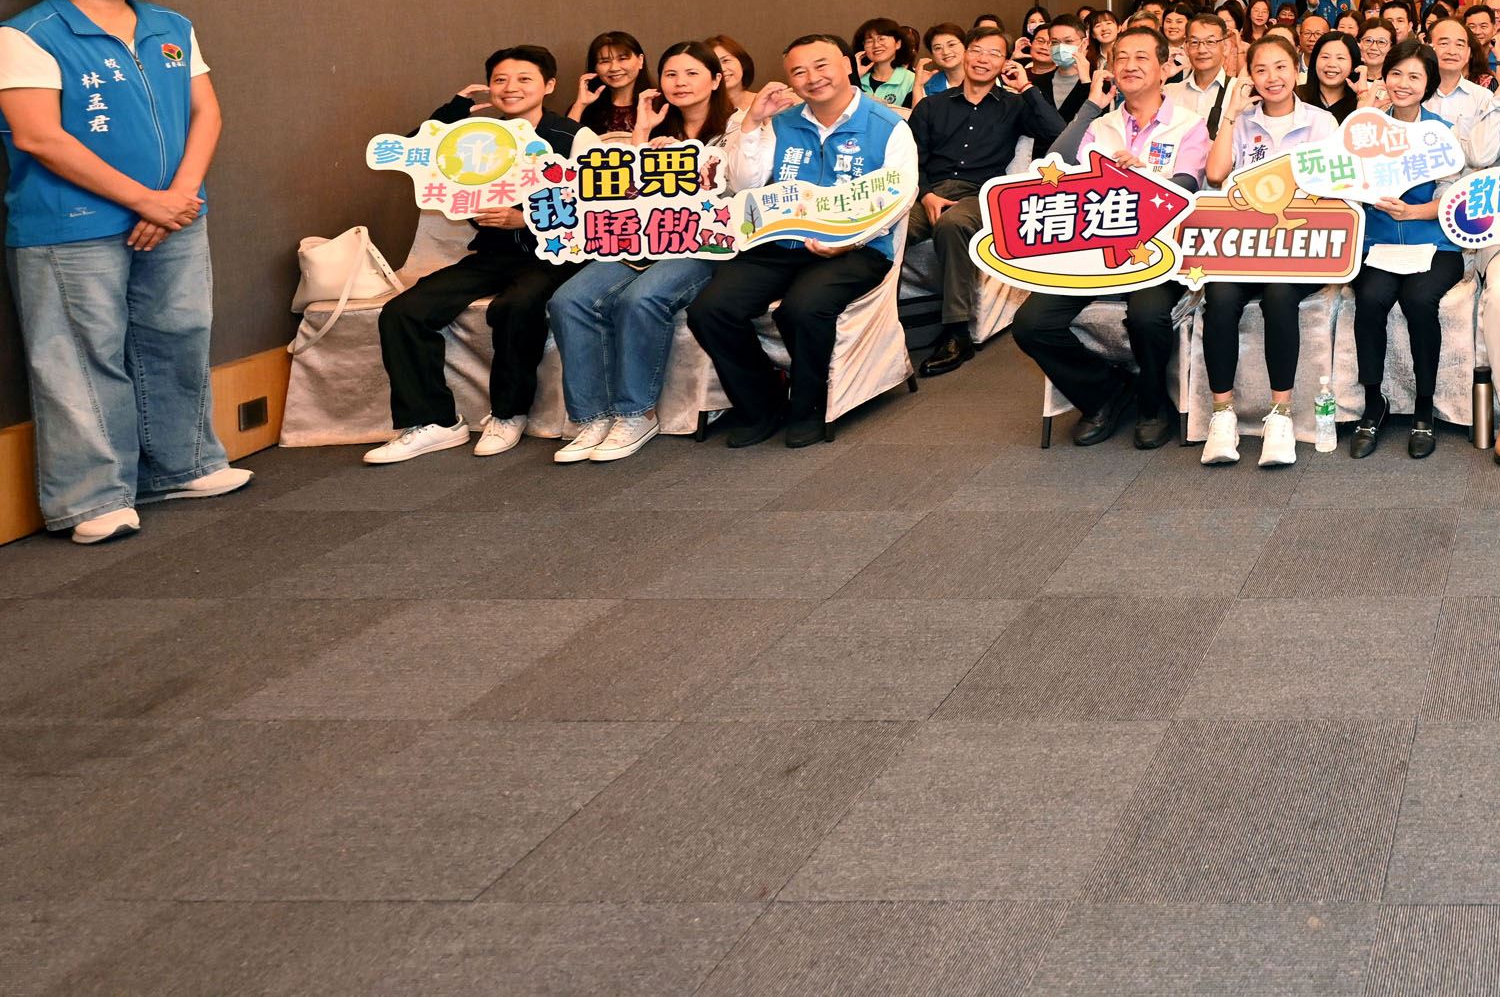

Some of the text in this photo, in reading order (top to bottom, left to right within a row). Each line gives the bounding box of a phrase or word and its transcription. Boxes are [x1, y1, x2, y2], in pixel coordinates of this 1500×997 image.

[103, 58, 127, 82] 校長
[81, 71, 111, 133] 林孟君
[373, 139, 431, 167] 參與
[1349, 121, 1411, 153] 數位
[577, 145, 701, 202] 苗栗
[1296, 148, 1356, 183] 玩出
[1373, 142, 1456, 188] 新模式
[421, 167, 541, 215] 共創未來
[529, 187, 578, 233] 我
[761, 170, 901, 213] 雙語 從生活開始
[584, 208, 702, 256] 驕傲
[1017, 186, 1140, 246] 精進
[1181, 228, 1347, 258] EXCELLENT
